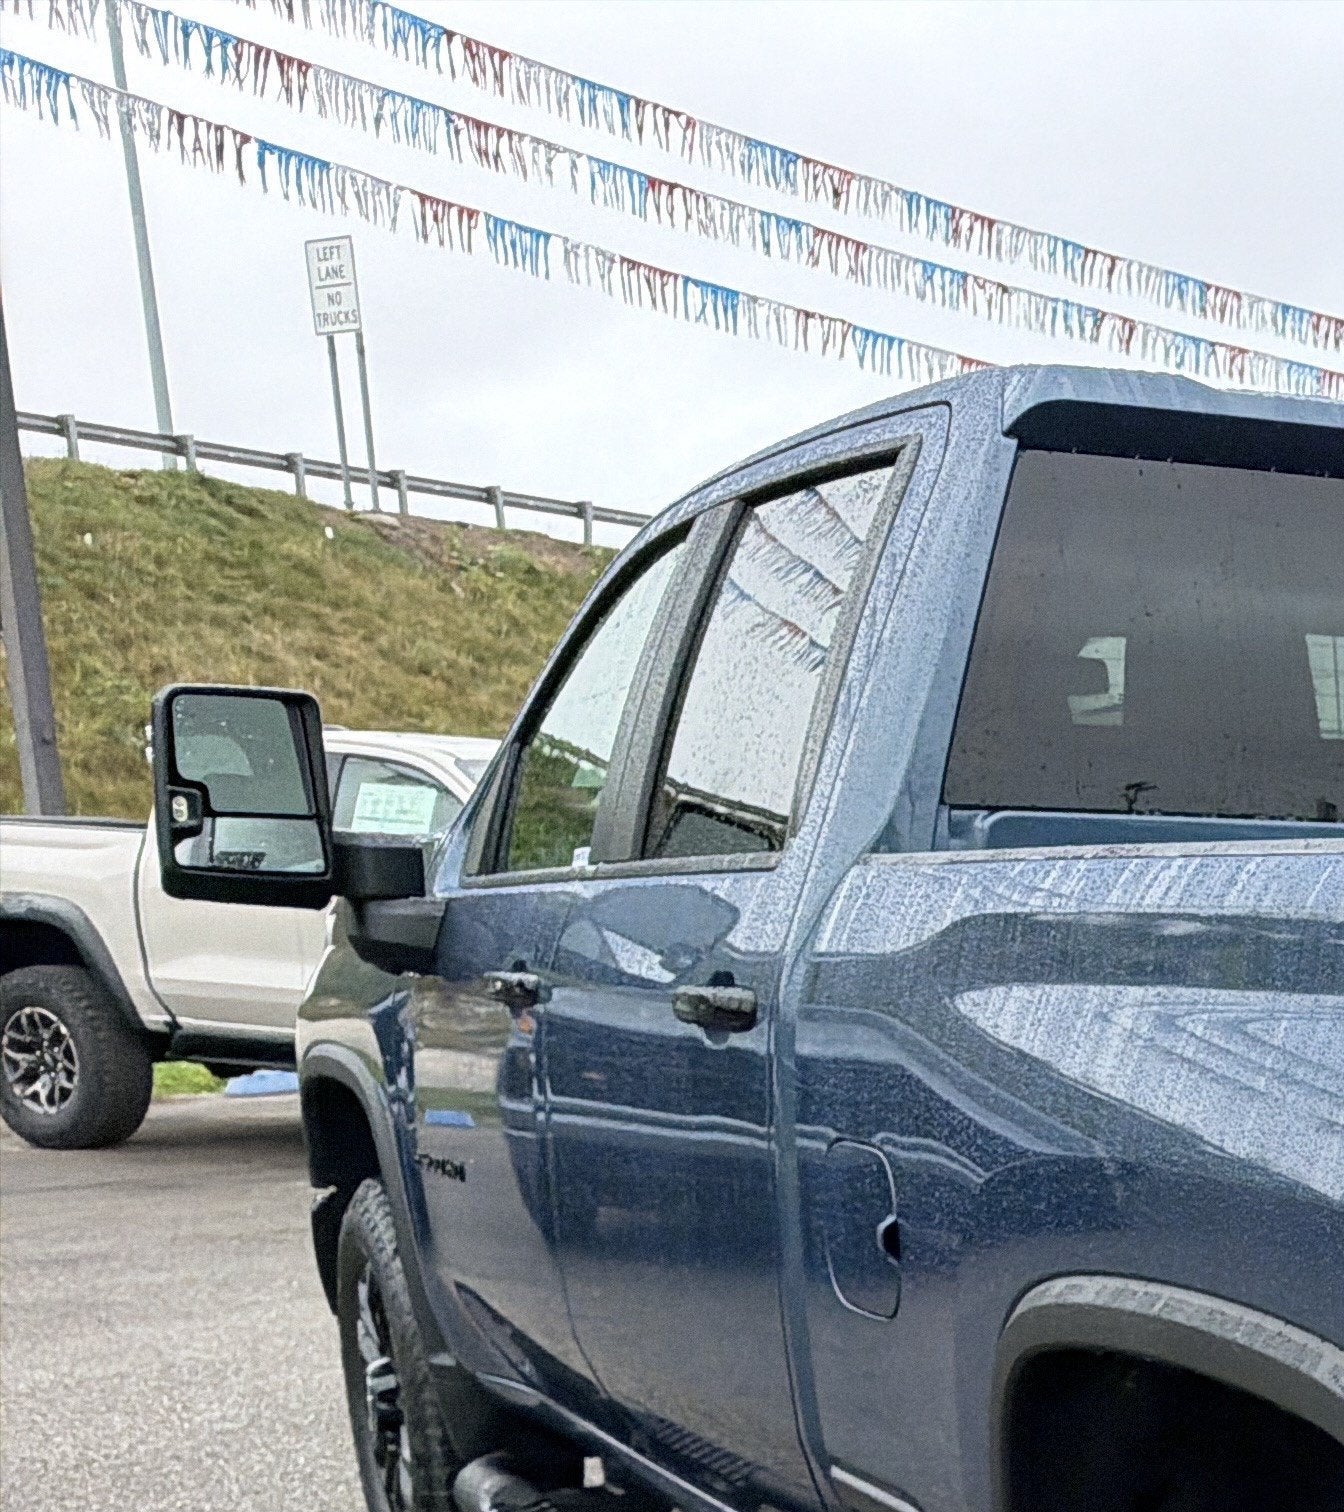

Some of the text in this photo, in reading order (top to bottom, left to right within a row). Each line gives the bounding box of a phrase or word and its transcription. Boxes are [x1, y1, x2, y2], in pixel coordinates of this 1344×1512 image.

[316, 244, 341, 262] LEFT
[318, 264, 346, 281] LANE
[327, 292, 343, 306] NO
[316, 309, 358, 328] TRUCKS
